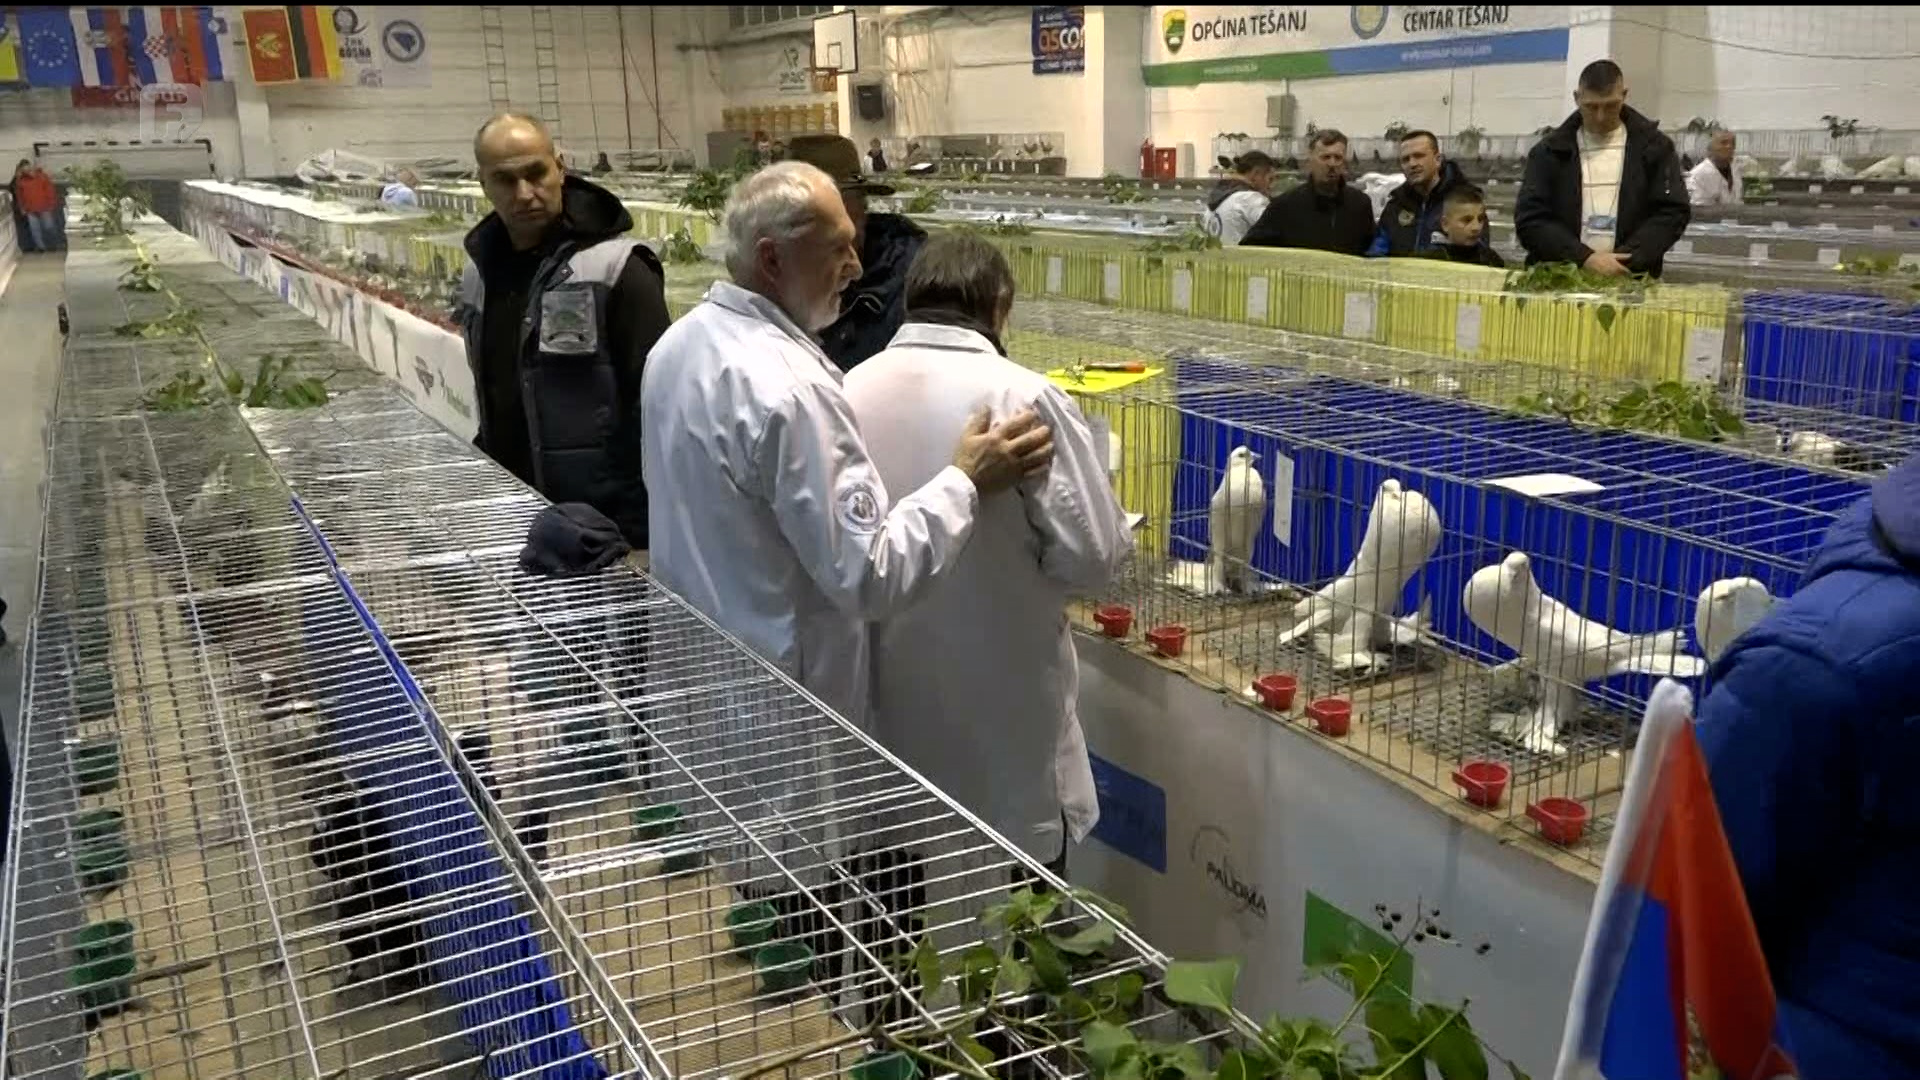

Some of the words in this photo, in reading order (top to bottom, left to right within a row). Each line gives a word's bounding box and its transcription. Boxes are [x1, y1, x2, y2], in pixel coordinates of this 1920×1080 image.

[1192, 16, 1247, 42] OPĆINA
[1250, 9, 1307, 35] TEŠANJ
[1403, 8, 1454, 33] CENTAR
